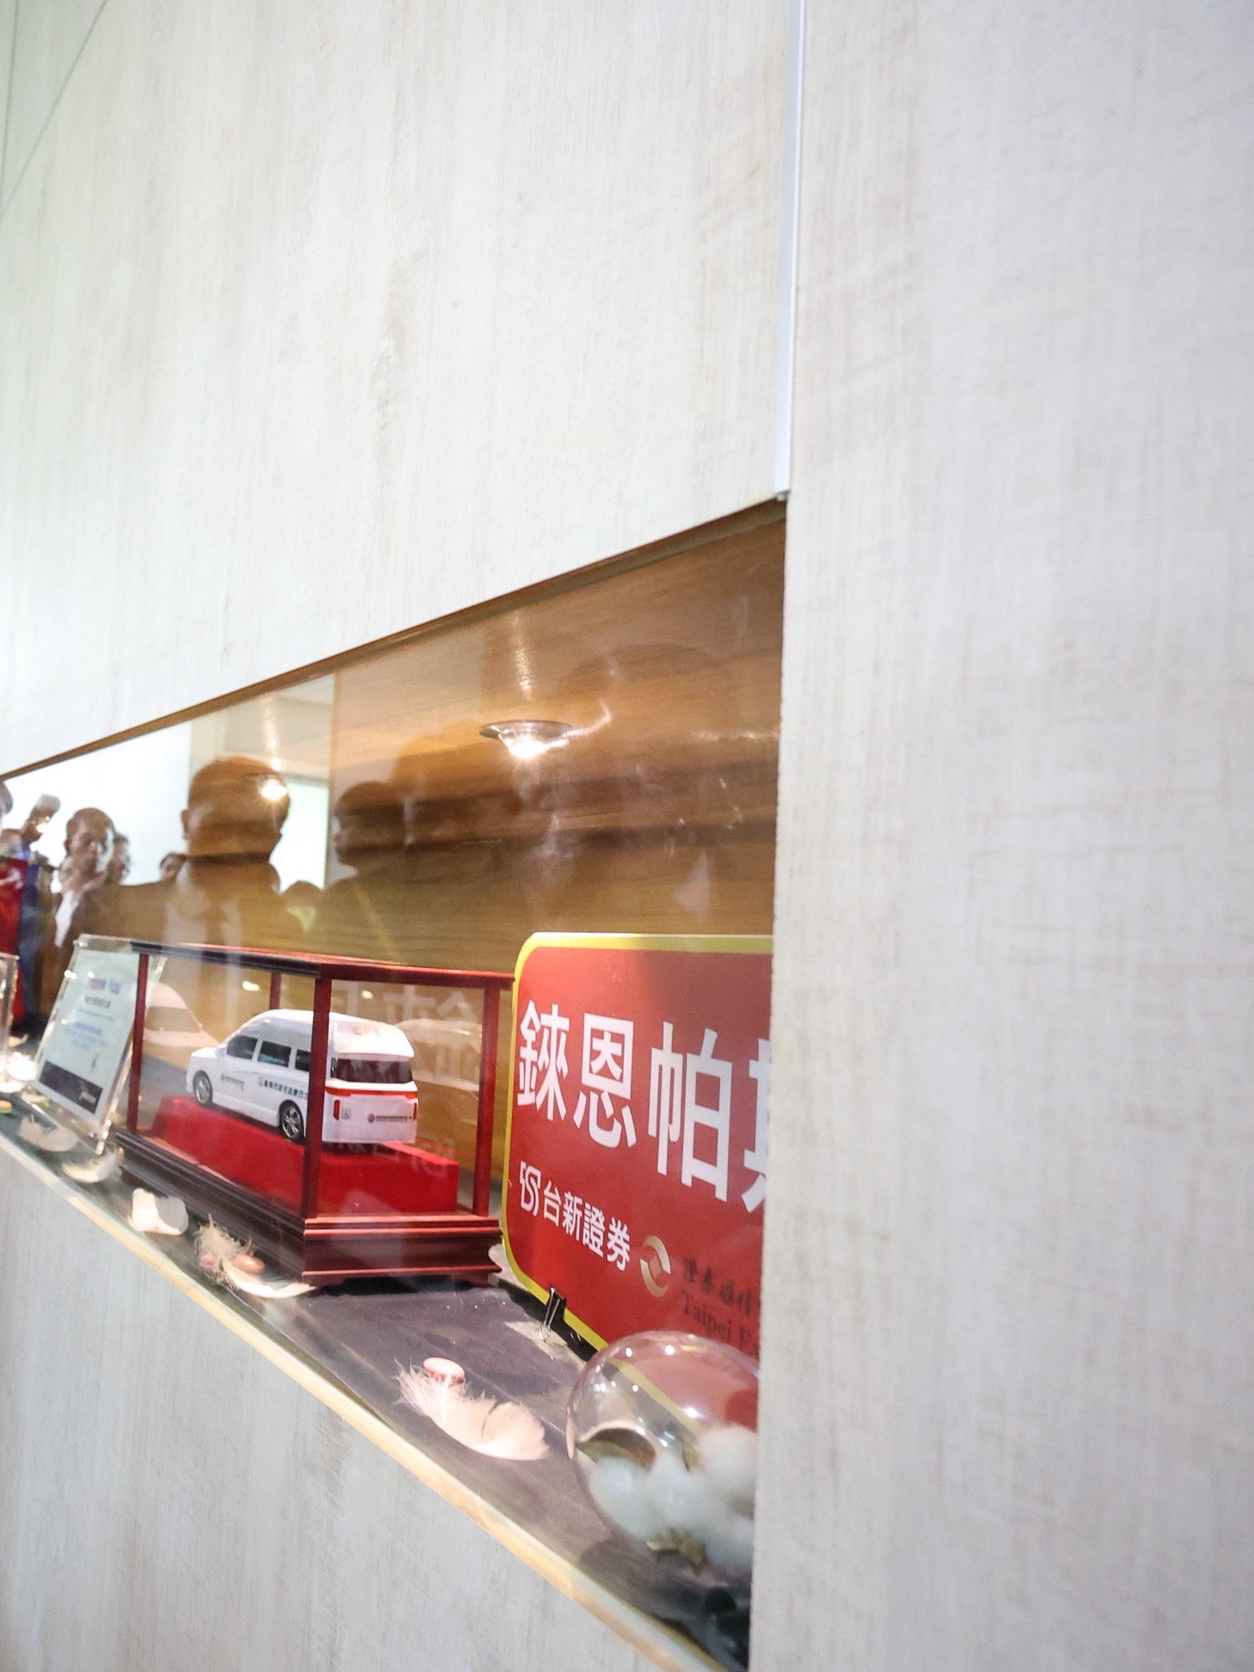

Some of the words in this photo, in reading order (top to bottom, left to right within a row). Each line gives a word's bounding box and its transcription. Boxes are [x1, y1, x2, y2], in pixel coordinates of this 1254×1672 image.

[543, 1180, 630, 1271] 台新證券
[682, 1289, 732, 1343] Taipei
